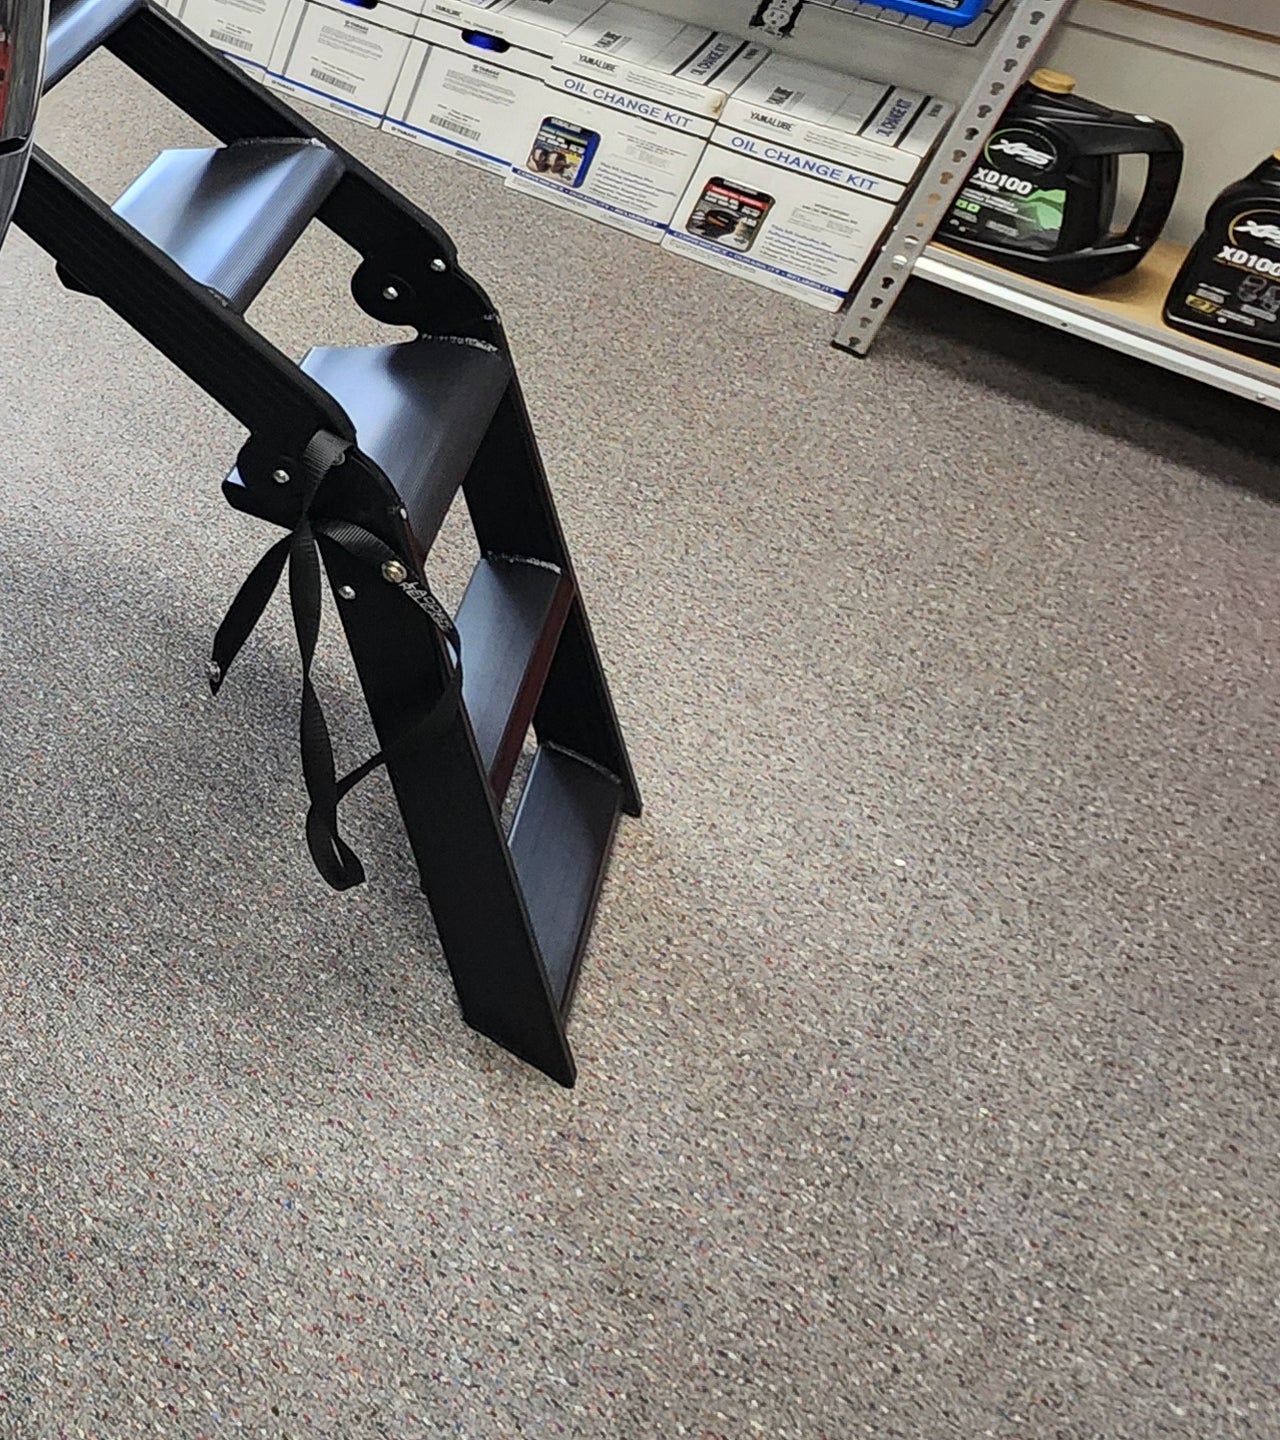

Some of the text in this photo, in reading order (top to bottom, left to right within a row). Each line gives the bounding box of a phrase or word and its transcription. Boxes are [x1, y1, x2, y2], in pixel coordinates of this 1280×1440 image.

[578, 53, 621, 73] YAMALUBE
[564, 78, 693, 128] OIL CHANGE KIT
[749, 111, 795, 132] YAMALUBE
[730, 136, 878, 191] OIL CHANGE KIT
[972, 166, 1033, 195] XD100
